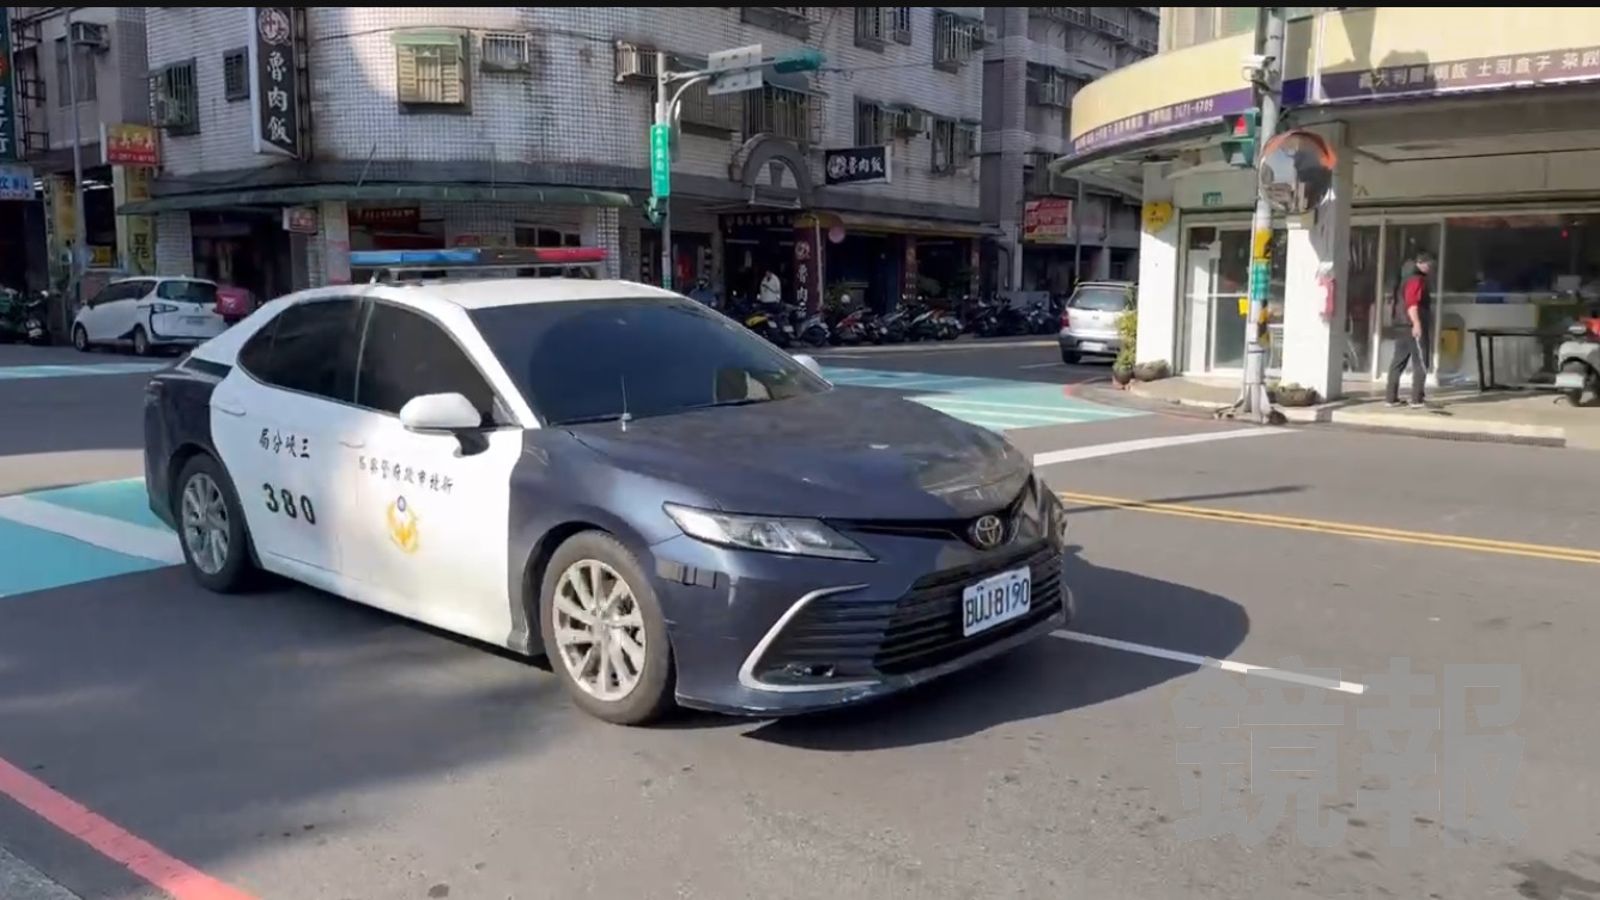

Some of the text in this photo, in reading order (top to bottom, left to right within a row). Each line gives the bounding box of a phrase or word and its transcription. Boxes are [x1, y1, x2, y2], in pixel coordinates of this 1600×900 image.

[267, 51, 292, 144] 魯肉飯
[261, 482, 316, 525] 380
